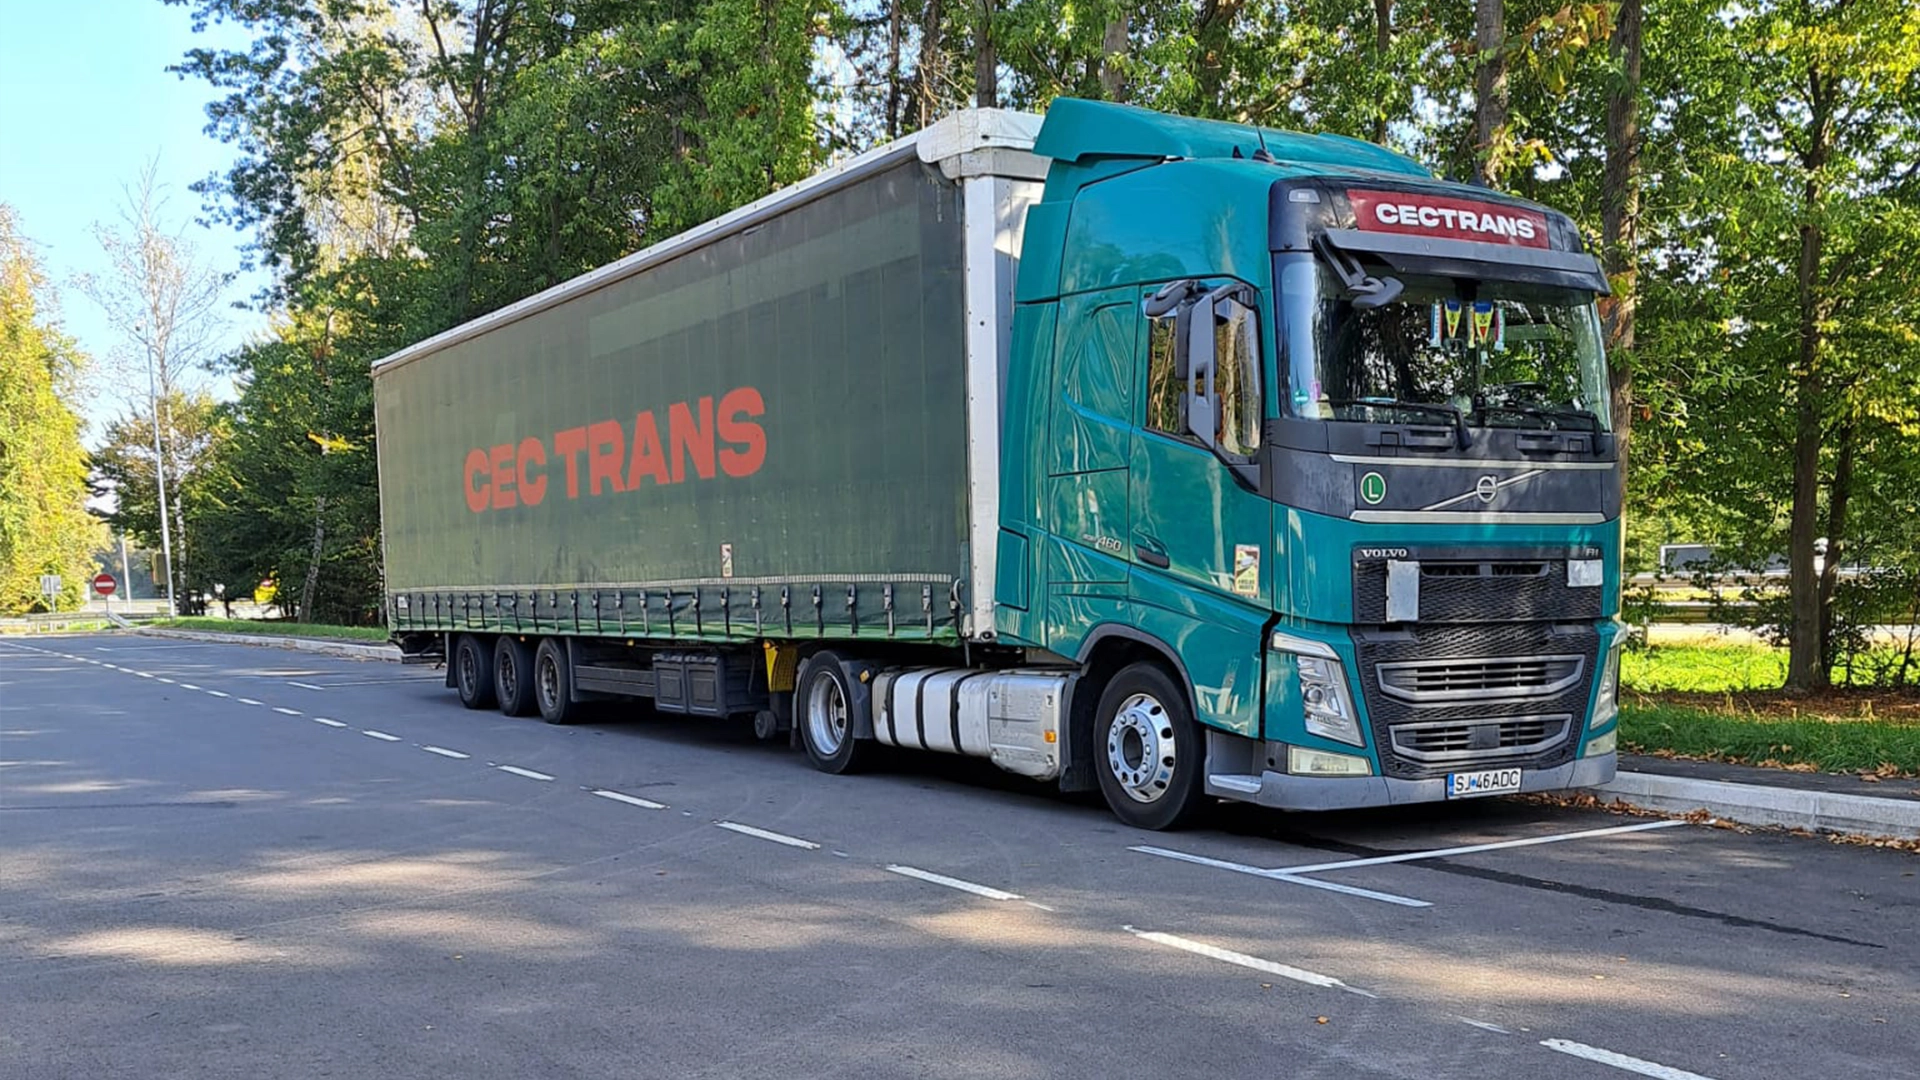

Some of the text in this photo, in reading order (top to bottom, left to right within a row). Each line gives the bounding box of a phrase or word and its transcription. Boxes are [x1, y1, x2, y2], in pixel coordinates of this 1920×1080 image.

[1375, 203, 1535, 239] CECTRANS
[463, 387, 767, 513] CEC TRANS
[1368, 477, 1379, 498] L
[1098, 535, 1122, 551] 460
[1361, 548, 1408, 558] VOLVO
